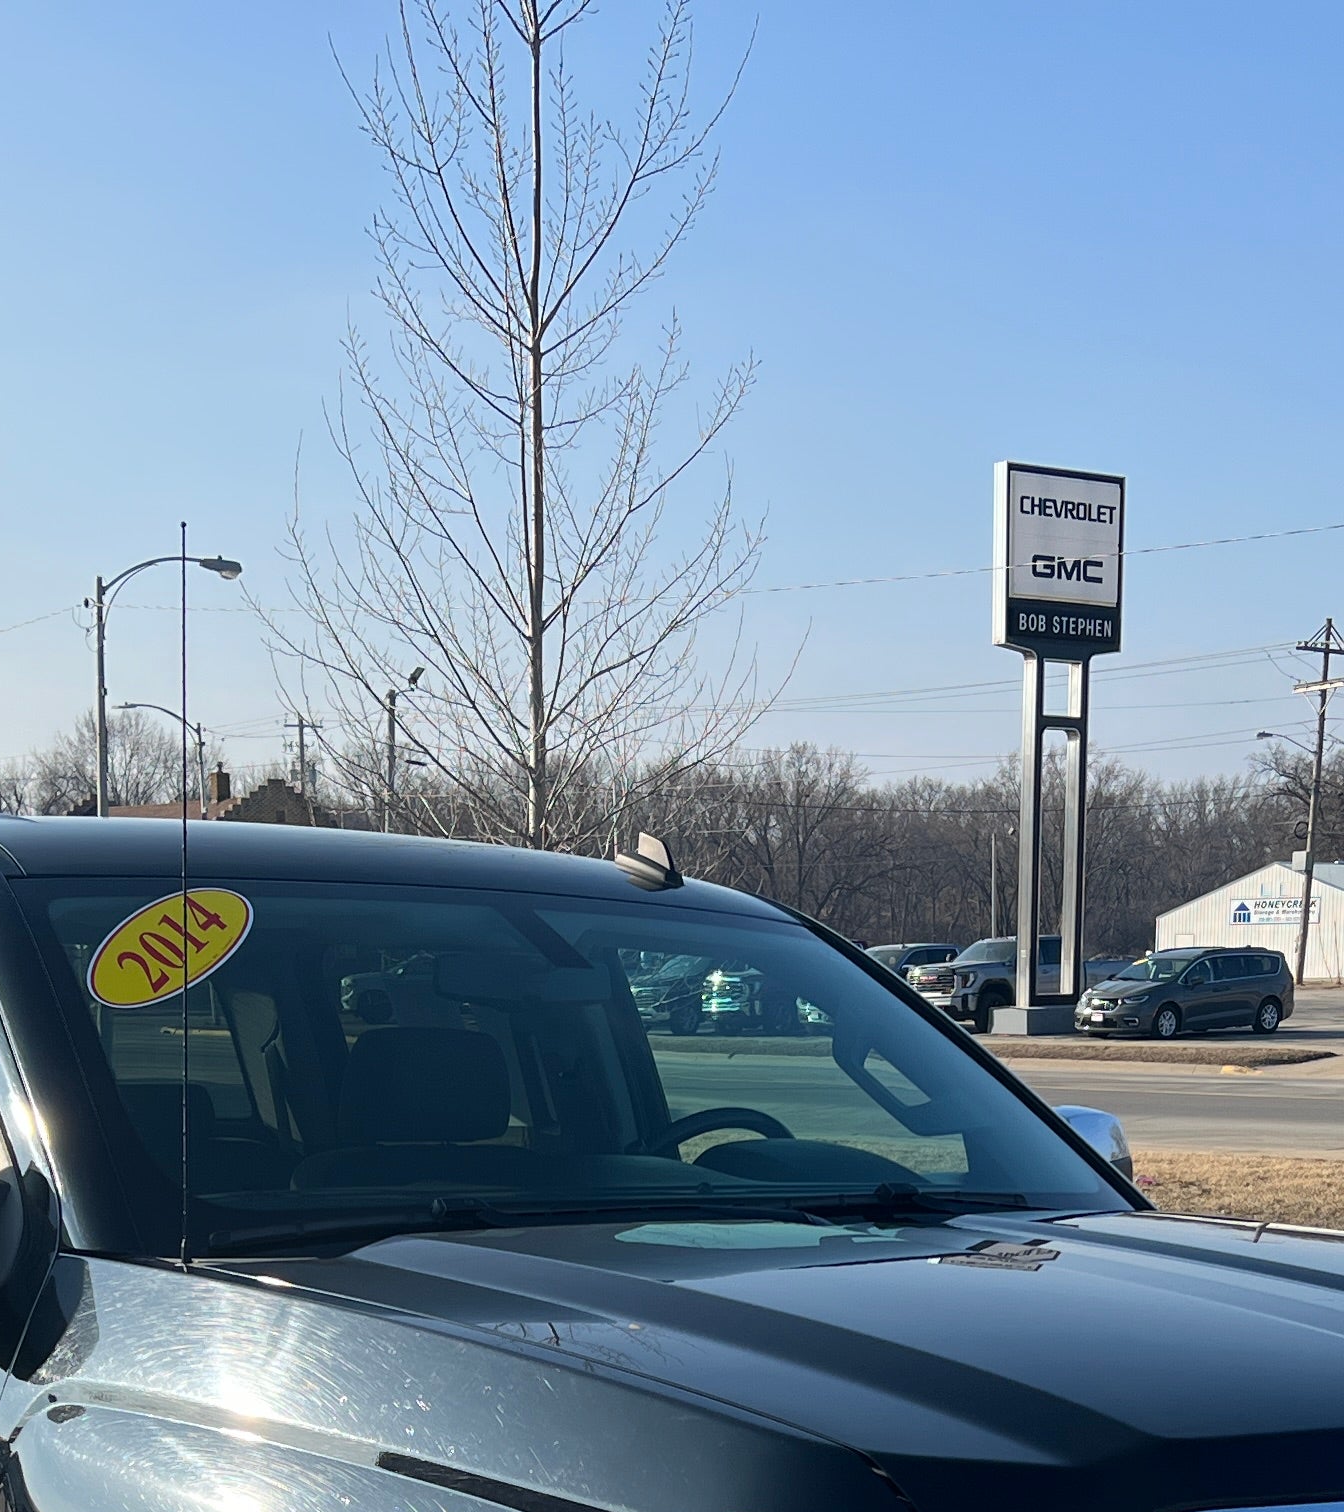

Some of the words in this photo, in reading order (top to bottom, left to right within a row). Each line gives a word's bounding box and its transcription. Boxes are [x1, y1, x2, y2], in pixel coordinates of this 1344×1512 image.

[1019, 495, 1117, 525] CHEVROLET
[1031, 554, 1104, 584] GMC
[1018, 613, 1047, 633] BOB
[1052, 615, 1113, 638] STEPHEN
[1253, 900, 1317, 909] HONEYCREK
[117, 895, 228, 994] 2014
